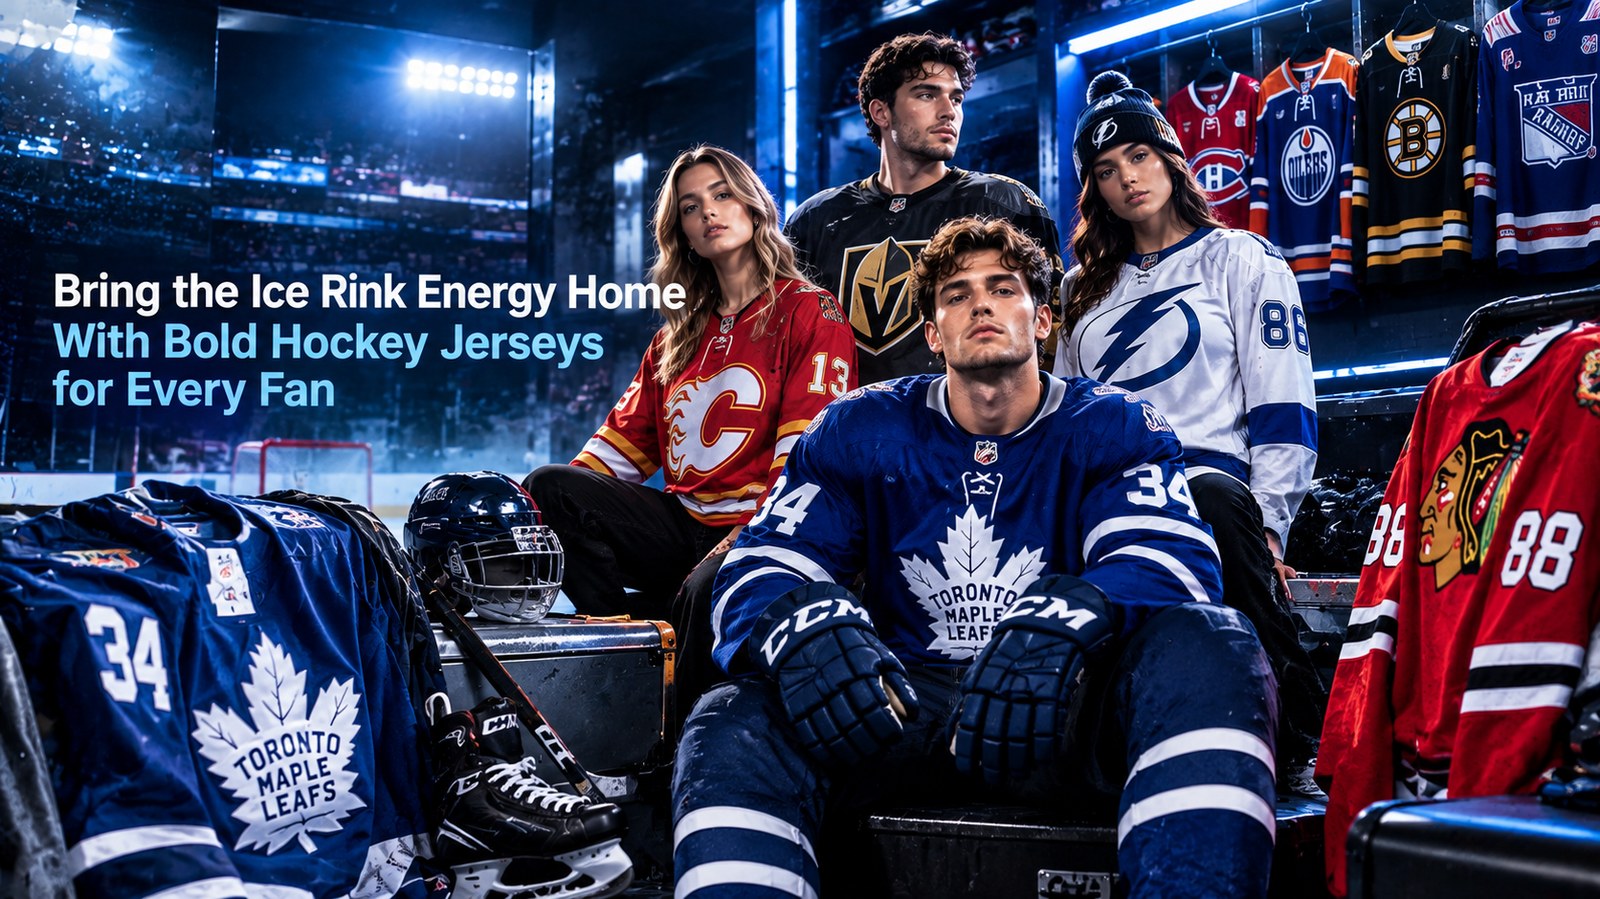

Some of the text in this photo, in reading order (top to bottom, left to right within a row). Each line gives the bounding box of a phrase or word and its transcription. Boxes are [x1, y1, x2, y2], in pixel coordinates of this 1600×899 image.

[1399, 116, 1428, 161] B
[1259, 299, 1310, 356] 86
[807, 352, 849, 398] 13
[1122, 462, 1201, 521] 34
[1500, 509, 1584, 592] 88
[928, 582, 1018, 611] TORONTO
[945, 606, 1004, 624] MAPLE
[760, 598, 875, 667] CCM
[84, 604, 172, 713] 34
[233, 731, 341, 780] TORONTO
[256, 756, 332, 797] MAPLE
[260, 780, 337, 822] LEAFS
